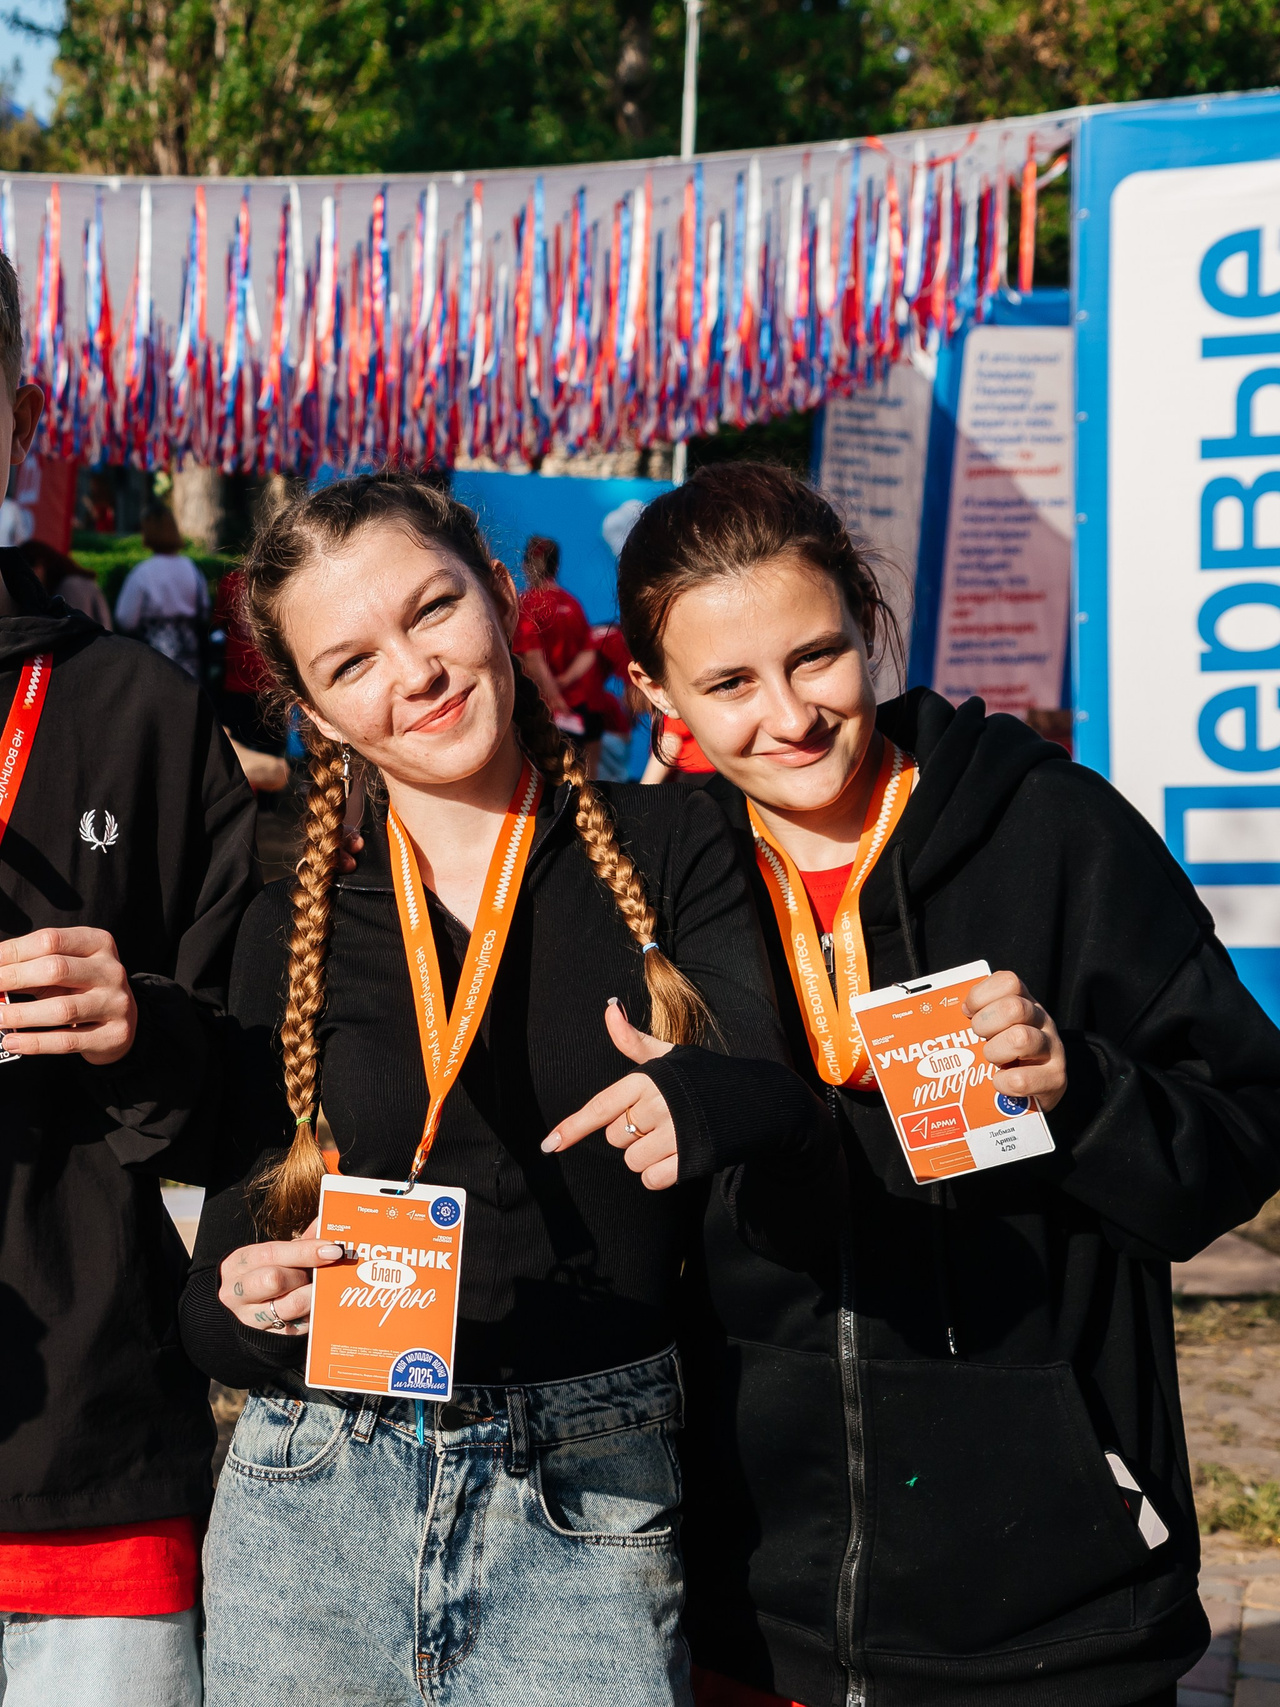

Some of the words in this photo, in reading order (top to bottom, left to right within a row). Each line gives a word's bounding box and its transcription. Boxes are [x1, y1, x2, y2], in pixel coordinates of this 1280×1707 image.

[1163, 226, 1280, 886] Первые
[15, 727, 25, 748] не
[840, 910, 850, 929] не
[415, 946, 425, 962] не
[468, 929, 497, 994] волнуйтесь
[794, 932, 824, 1015] волнуйтесь
[840, 931, 860, 1006] волнуйте
[418, 962, 437, 1029] волнуйтесь
[465, 994, 477, 1010] не
[818, 1015, 831, 1033] не
[875, 1027, 987, 1069] УЧАСТНИ
[929, 1053, 961, 1074] благо
[930, 1117, 958, 1131] АРМИ
[1001, 1144, 1017, 1153] 4/20
[334, 1240, 453, 1271] ЧАСТНИК
[371, 1261, 402, 1284] благо
[339, 1285, 436, 1327] творю
[408, 1366, 433, 1385] 2025
